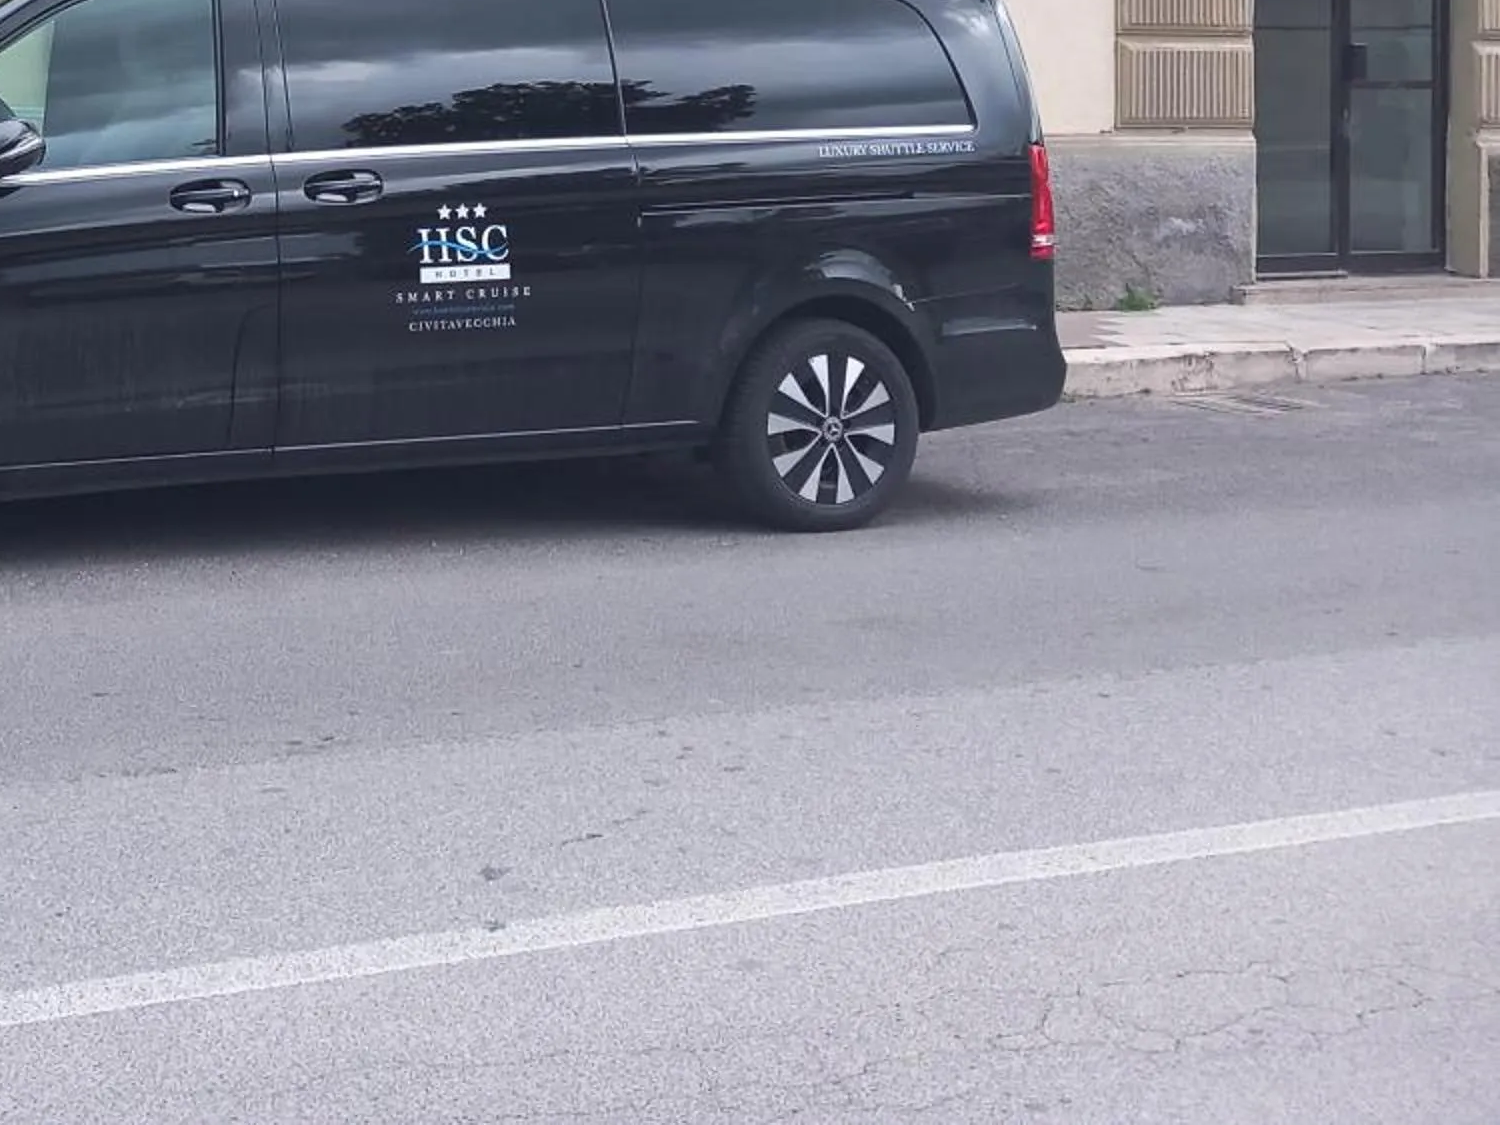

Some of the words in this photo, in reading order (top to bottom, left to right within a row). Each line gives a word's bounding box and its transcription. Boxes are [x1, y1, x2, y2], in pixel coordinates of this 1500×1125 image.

[819, 145, 868, 158] LUXURY
[869, 143, 925, 156] SHUTTLE
[926, 141, 976, 154] SERVICE
[417, 225, 509, 264] HSC
[435, 268, 496, 278] HOTEL
[396, 289, 455, 303] SMART
[466, 286, 531, 300] CRUISE
[409, 316, 517, 332] CIVITAVECCHIA
